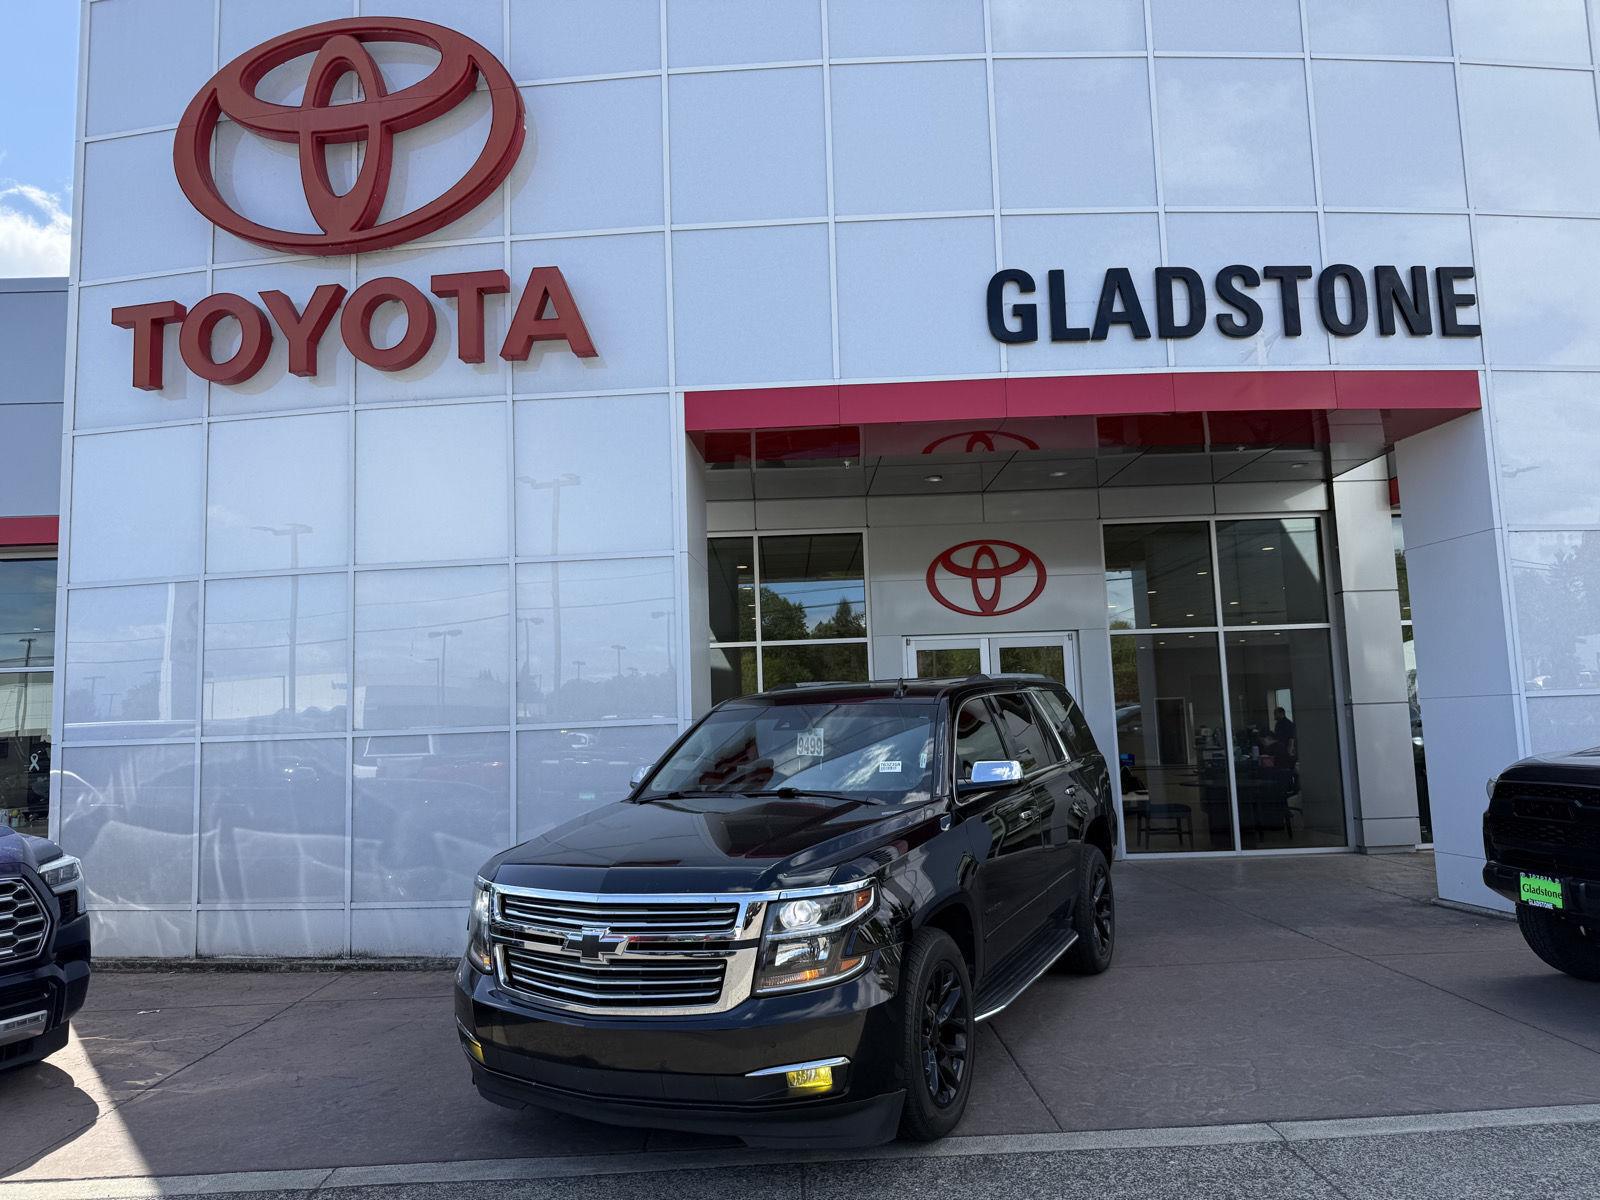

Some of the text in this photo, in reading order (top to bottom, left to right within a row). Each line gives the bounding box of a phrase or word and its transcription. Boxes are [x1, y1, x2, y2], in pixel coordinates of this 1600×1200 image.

[986, 263, 1482, 343] GLADSTONE
[111, 266, 599, 391] TOYOTA
[798, 737, 822, 755] 9499
[1522, 883, 1562, 899] Gladstone
